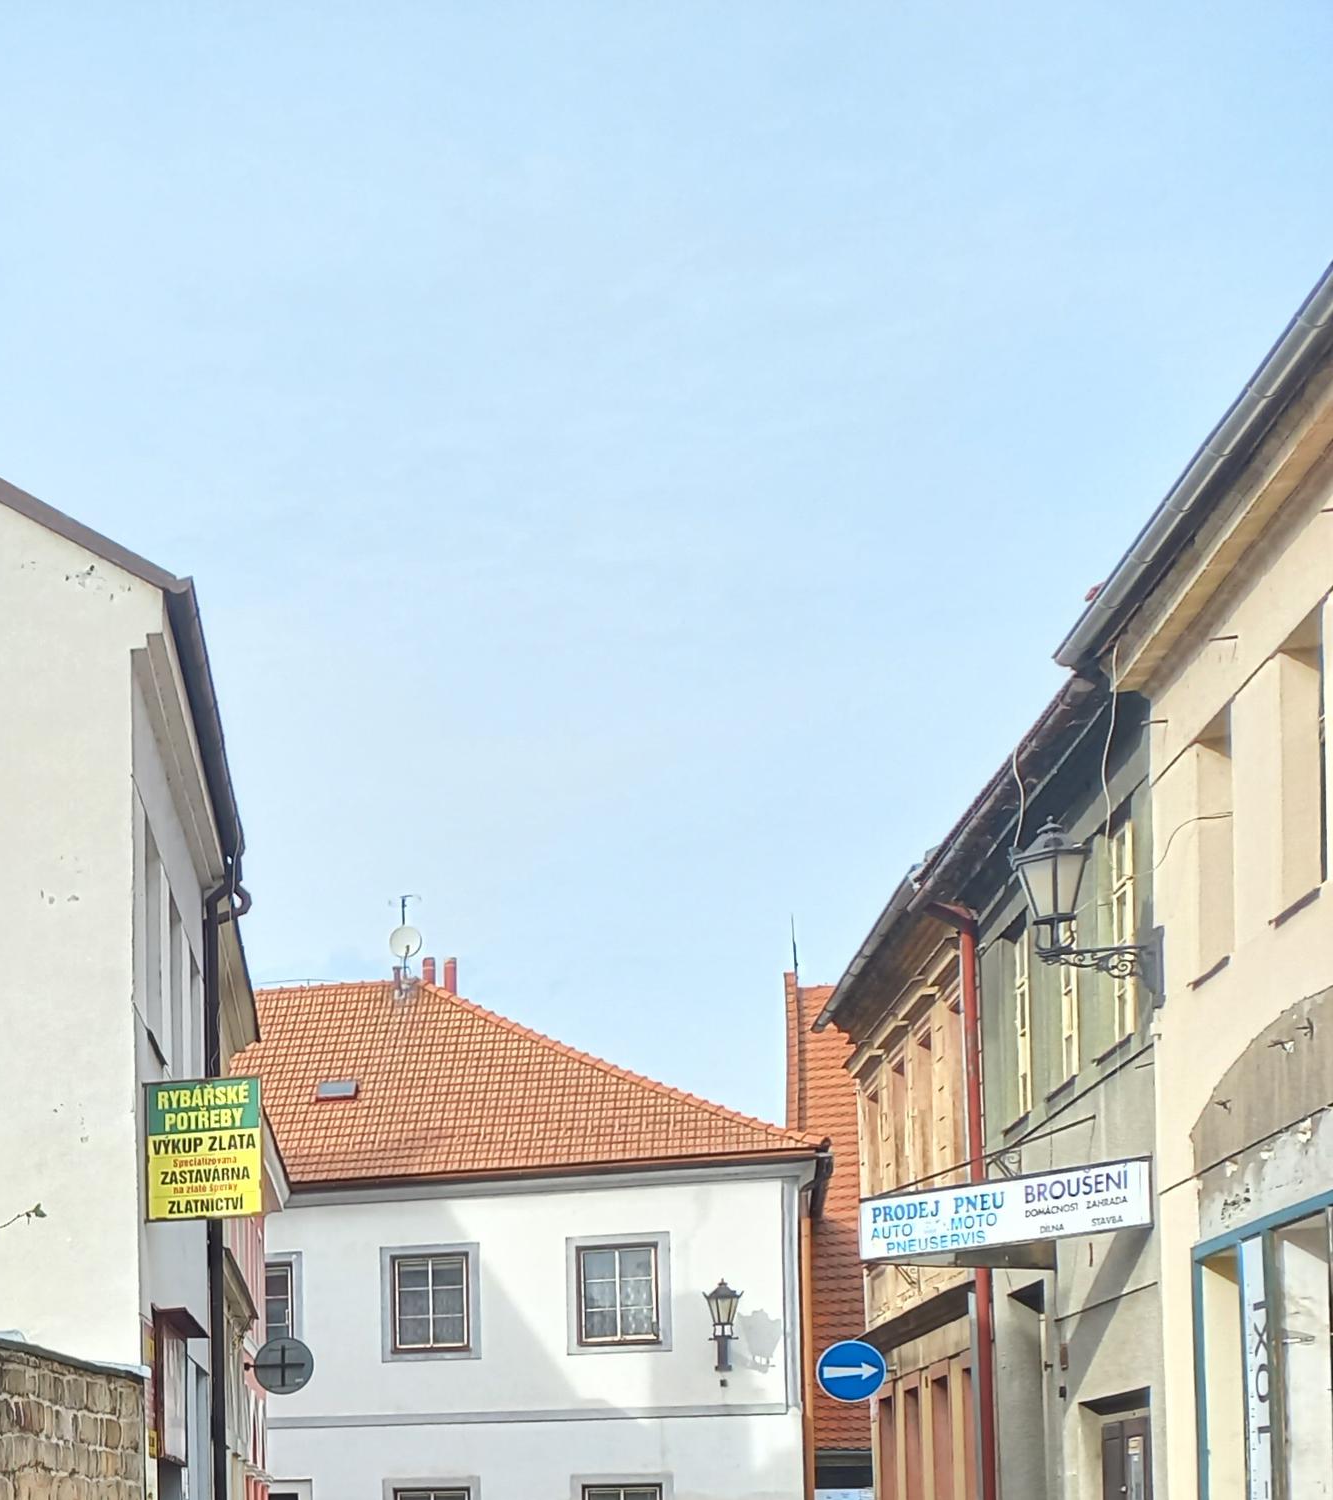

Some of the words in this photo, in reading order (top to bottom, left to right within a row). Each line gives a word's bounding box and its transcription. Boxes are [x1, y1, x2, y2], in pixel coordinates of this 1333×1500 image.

[157, 1080, 250, 1110] RYBÁŘSKÉ
[164, 1106, 244, 1132] POTŘEBY
[153, 1136, 204, 1156] VÝKUP
[208, 1133, 256, 1152] ZLATA
[160, 1166, 251, 1185] ZASTAVÁRNA
[1024, 1163, 1128, 1204] BROUŠENÍ
[168, 1195, 244, 1215] ZLATNICTVÍ
[871, 1200, 940, 1224] PRODEJ
[953, 1191, 1005, 1215] PNEU
[871, 1223, 913, 1241] AUTO
[950, 1212, 998, 1231] MOTO
[886, 1230, 986, 1254] PNEUSERVIS
